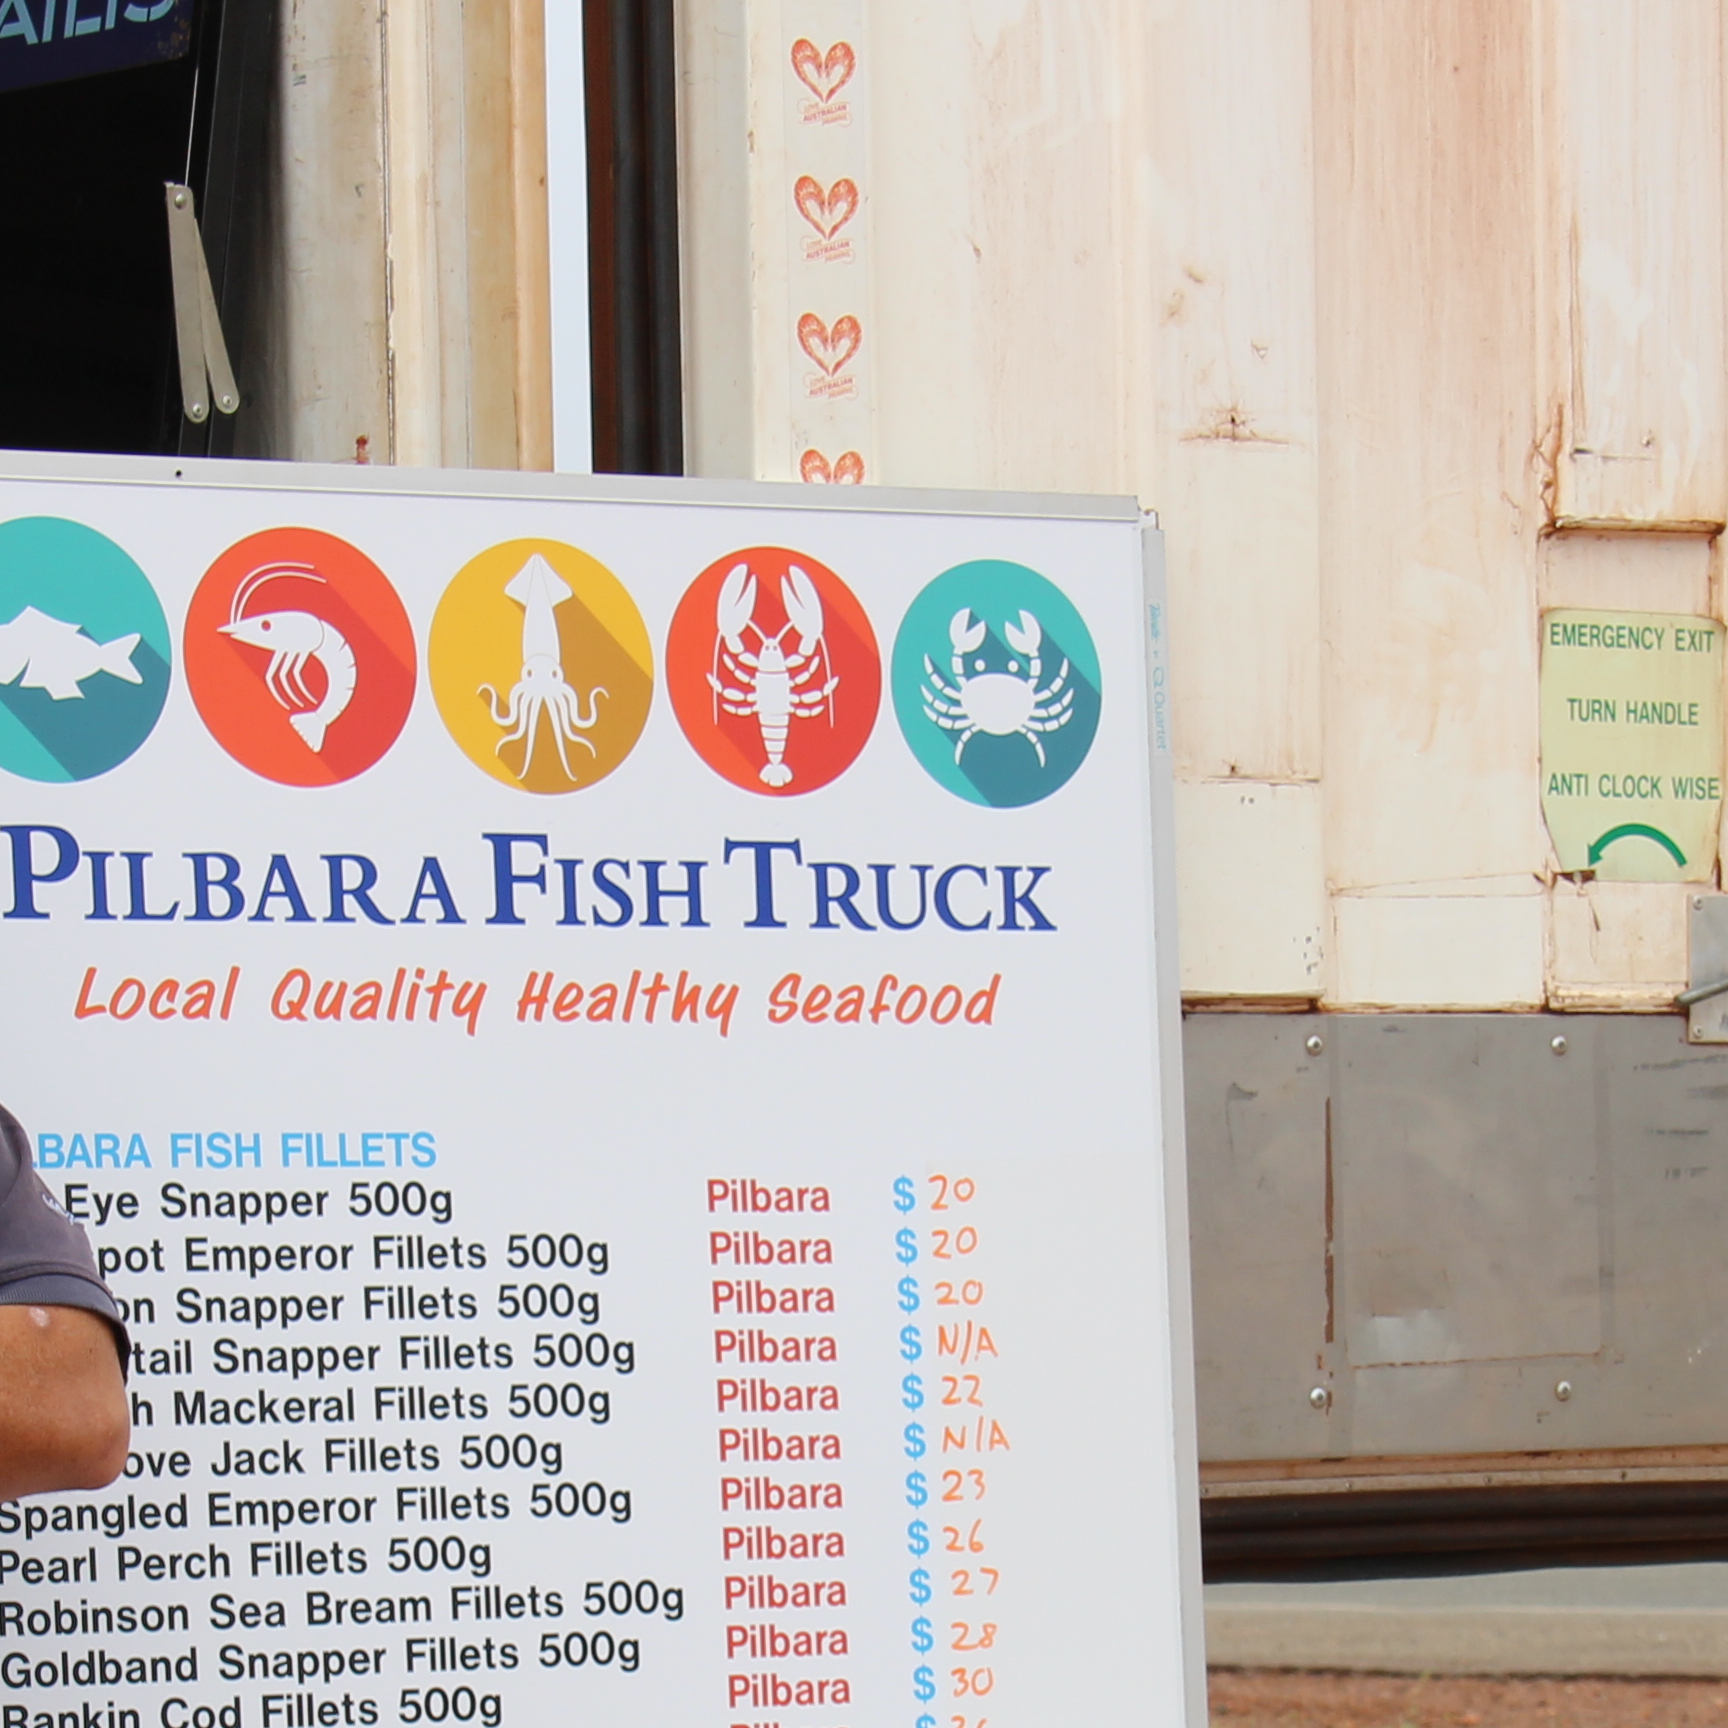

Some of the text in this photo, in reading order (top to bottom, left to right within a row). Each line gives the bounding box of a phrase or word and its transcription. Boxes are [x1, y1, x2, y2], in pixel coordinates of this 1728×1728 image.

[1549, 622, 1715, 653] EMERGENCY EXIT
[1566, 697, 1700, 726] TURN HANDLE
[1547, 771, 1721, 801] ANTI CLOCK WISE
[0, 825, 1058, 933] PILBARA FISH TRUCK
[74, 965, 1002, 1038] Local Quality Healthy Seafood
[168, 1130, 264, 1171] FISH
[279, 1129, 439, 1170] FILLETS
[62, 1183, 140, 1227] Eye
[160, 1181, 330, 1225] Snapper
[348, 1180, 453, 1224] 500g
[707, 1178, 831, 1213] Pilbara
[207, 1491, 378, 1533] Emperor
[395, 1485, 511, 1522] Fillets
[529, 1481, 632, 1524] 500g
[720, 1476, 844, 1511] Pilbara
[116, 1542, 231, 1582] Perch
[249, 1540, 368, 1577] Fillets
[387, 1534, 492, 1578] 500g
[722, 1525, 846, 1561] Pilbara
[209, 1592, 286, 1630] Sea
[305, 1590, 433, 1626] Bream
[450, 1584, 565, 1621] Fillets
[583, 1579, 685, 1622] 500g
[724, 1574, 848, 1610] Pilbara
